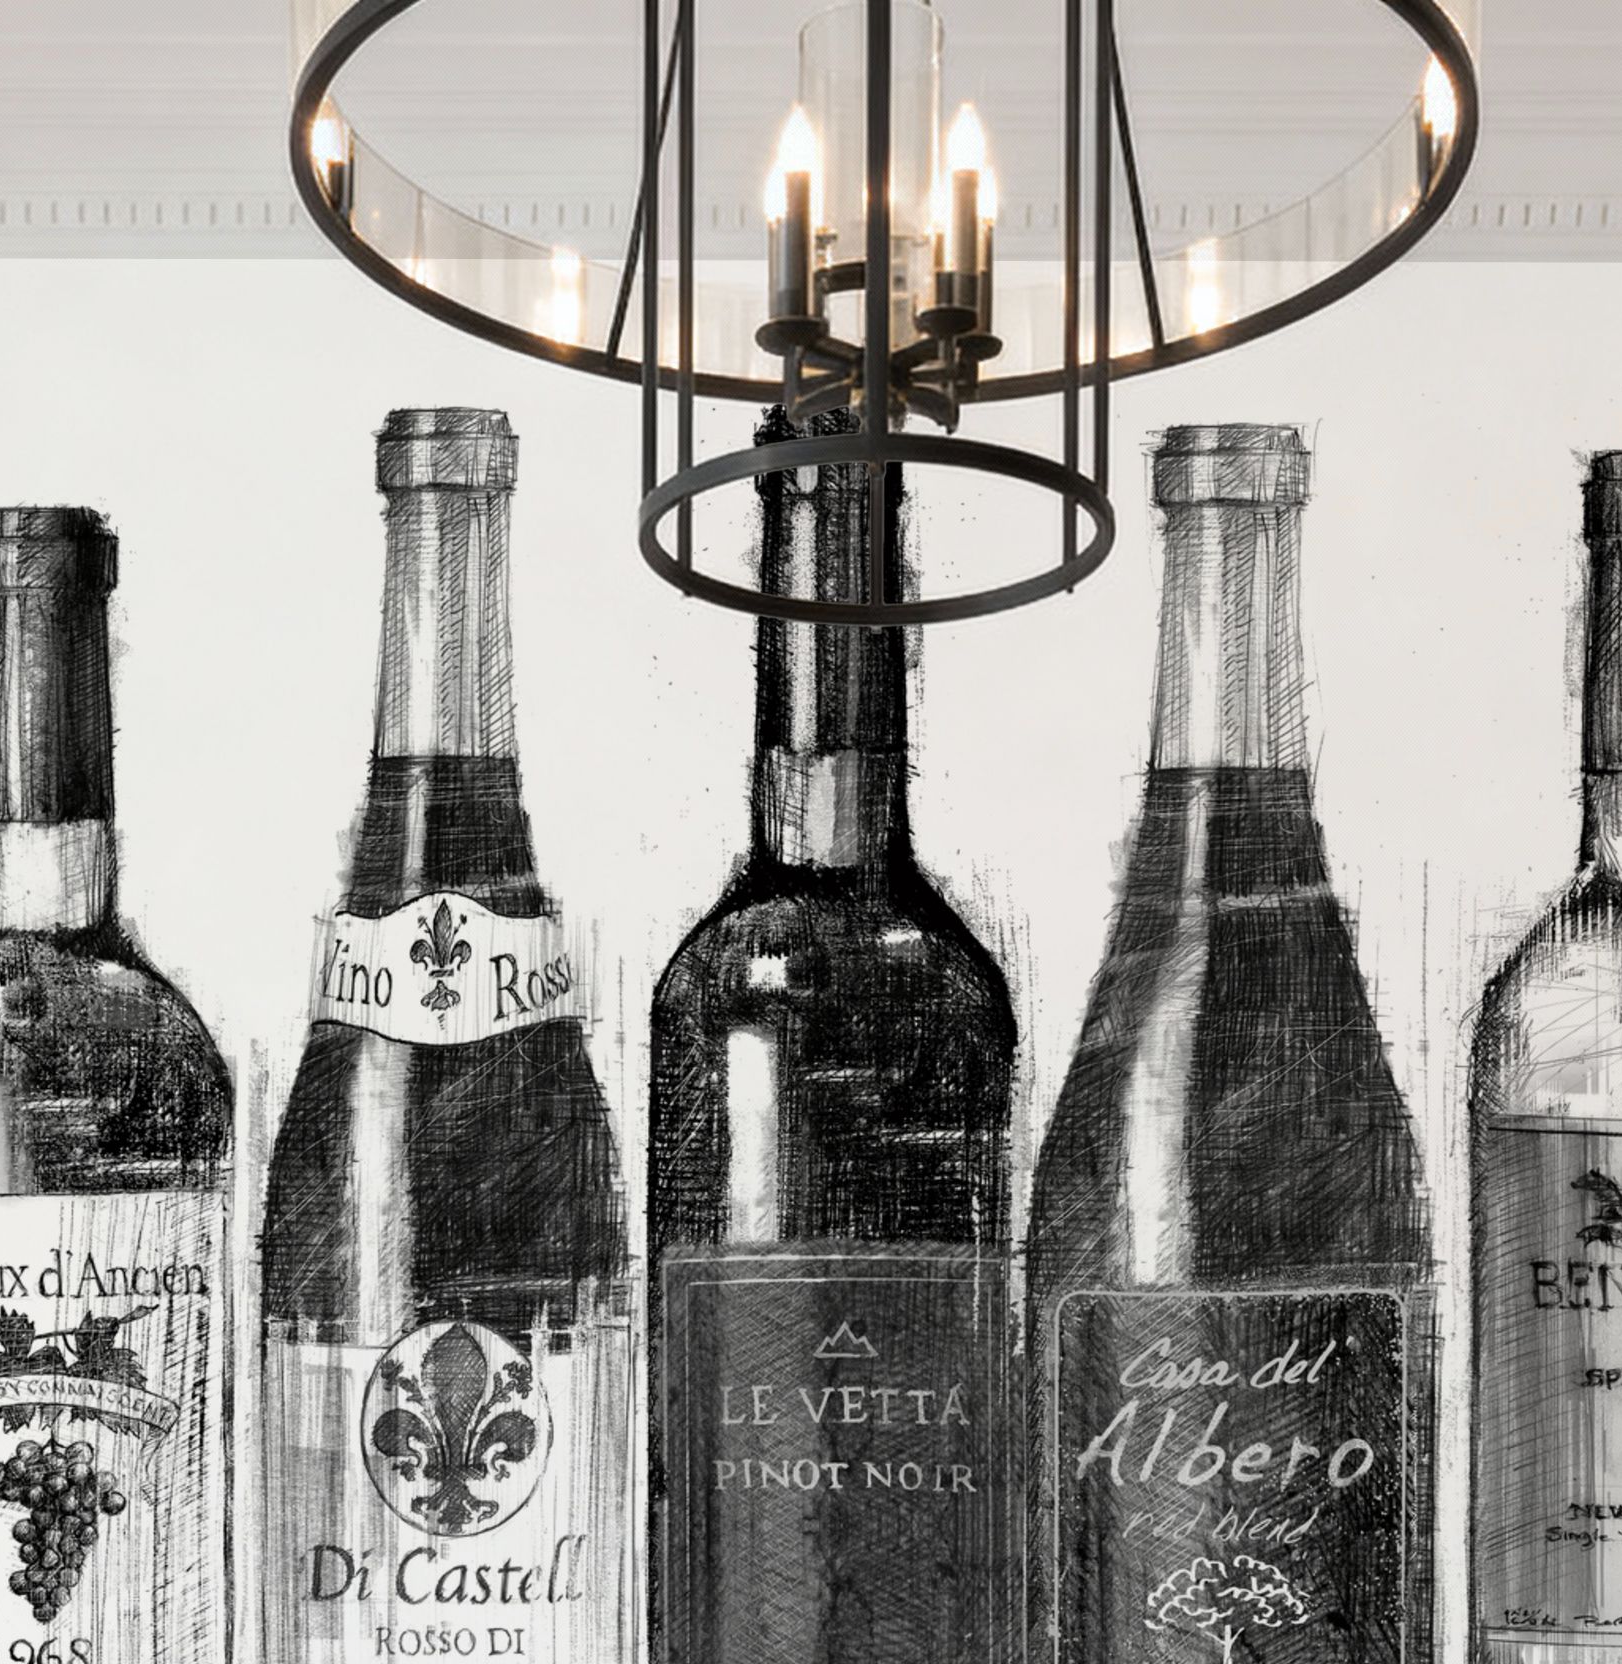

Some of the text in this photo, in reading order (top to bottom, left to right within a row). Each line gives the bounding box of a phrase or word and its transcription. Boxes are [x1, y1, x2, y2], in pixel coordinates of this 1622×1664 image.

[38, 1247, 211, 1298] d'Ancien
[1120, 1336, 1240, 1389] Casa
[720, 1382, 972, 1427] LE VETTA
[1078, 1400, 1375, 1488] Albero
[711, 1458, 978, 1494] PINOT NOIR
[309, 1544, 375, 1601] Di
[376, 1626, 526, 1657] ROSSO DI
